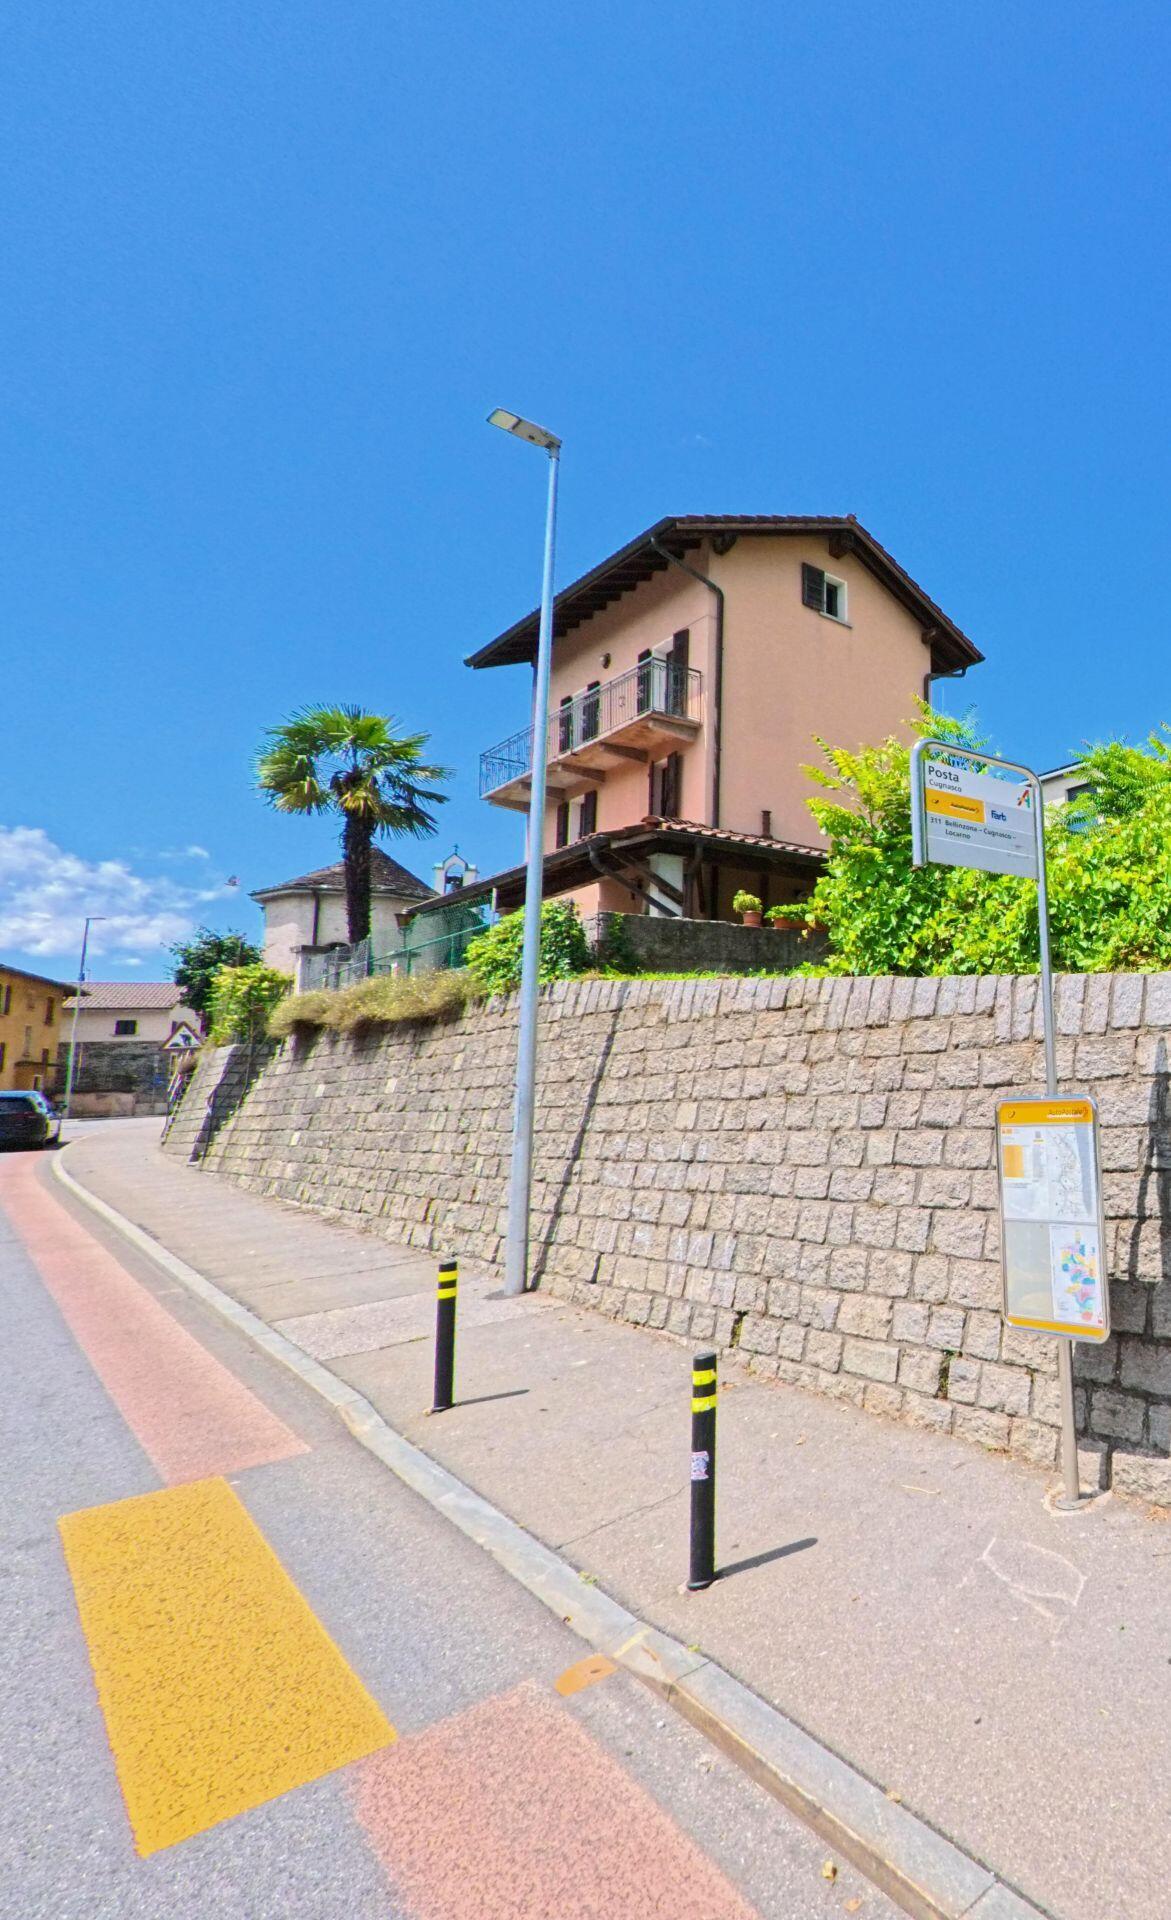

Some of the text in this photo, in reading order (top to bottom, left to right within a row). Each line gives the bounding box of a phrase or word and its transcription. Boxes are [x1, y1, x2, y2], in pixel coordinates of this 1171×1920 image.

[928, 765, 960, 782] Posta
[929, 778, 962, 793] Cugnasco
[945, 819, 978, 832] Bellinzona
[983, 828, 1012, 840] Cugnasco
[945, 829, 971, 839] Locarno
